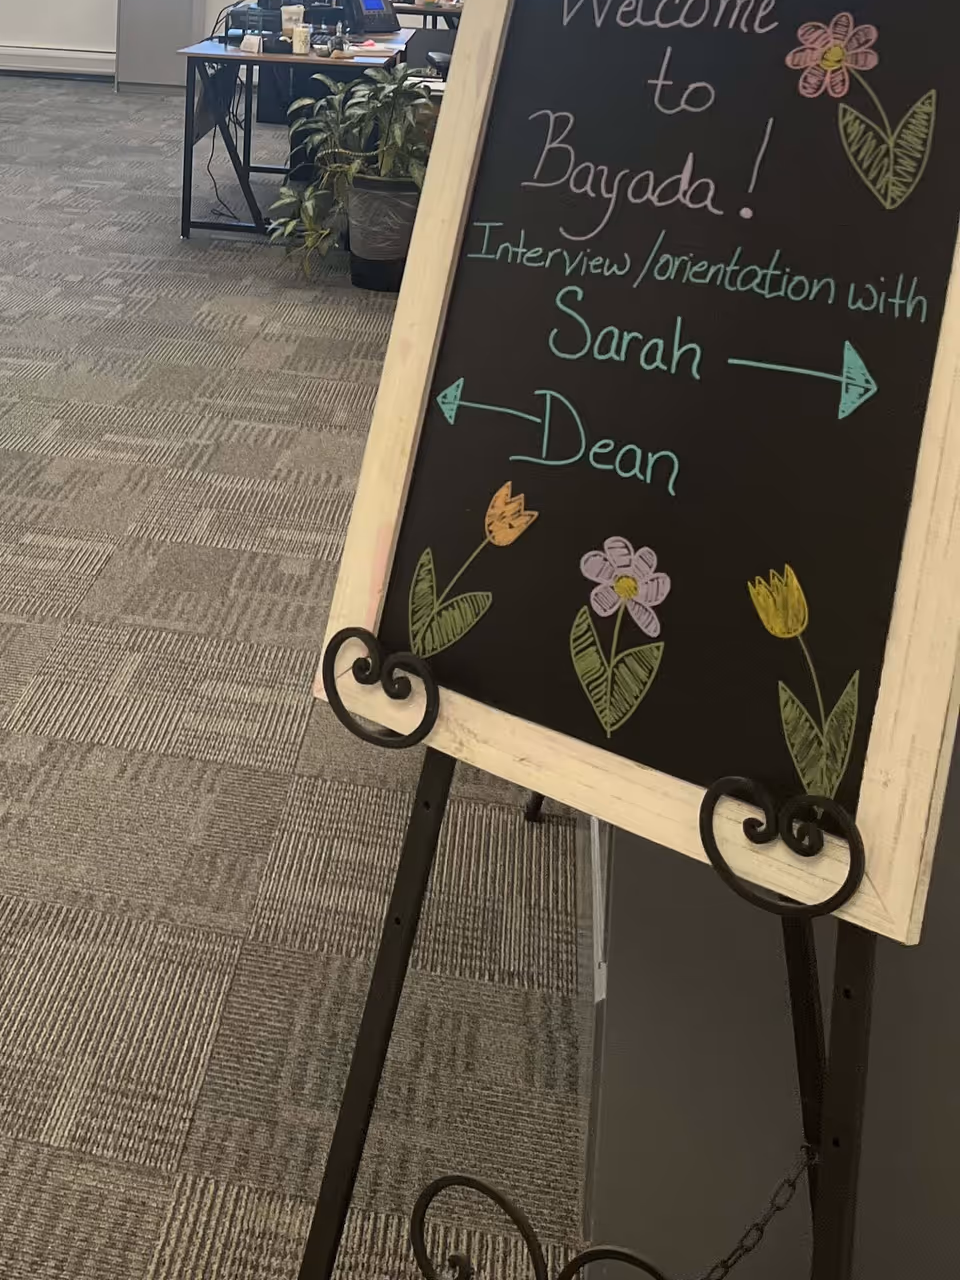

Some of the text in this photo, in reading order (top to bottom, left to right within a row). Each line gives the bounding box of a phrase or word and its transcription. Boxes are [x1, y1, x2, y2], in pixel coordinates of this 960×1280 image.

[647, 45, 716, 115] to
[548, 285, 701, 380] Sarah
[847, 273, 928, 323] with
[509, 389, 680, 497] Dean
